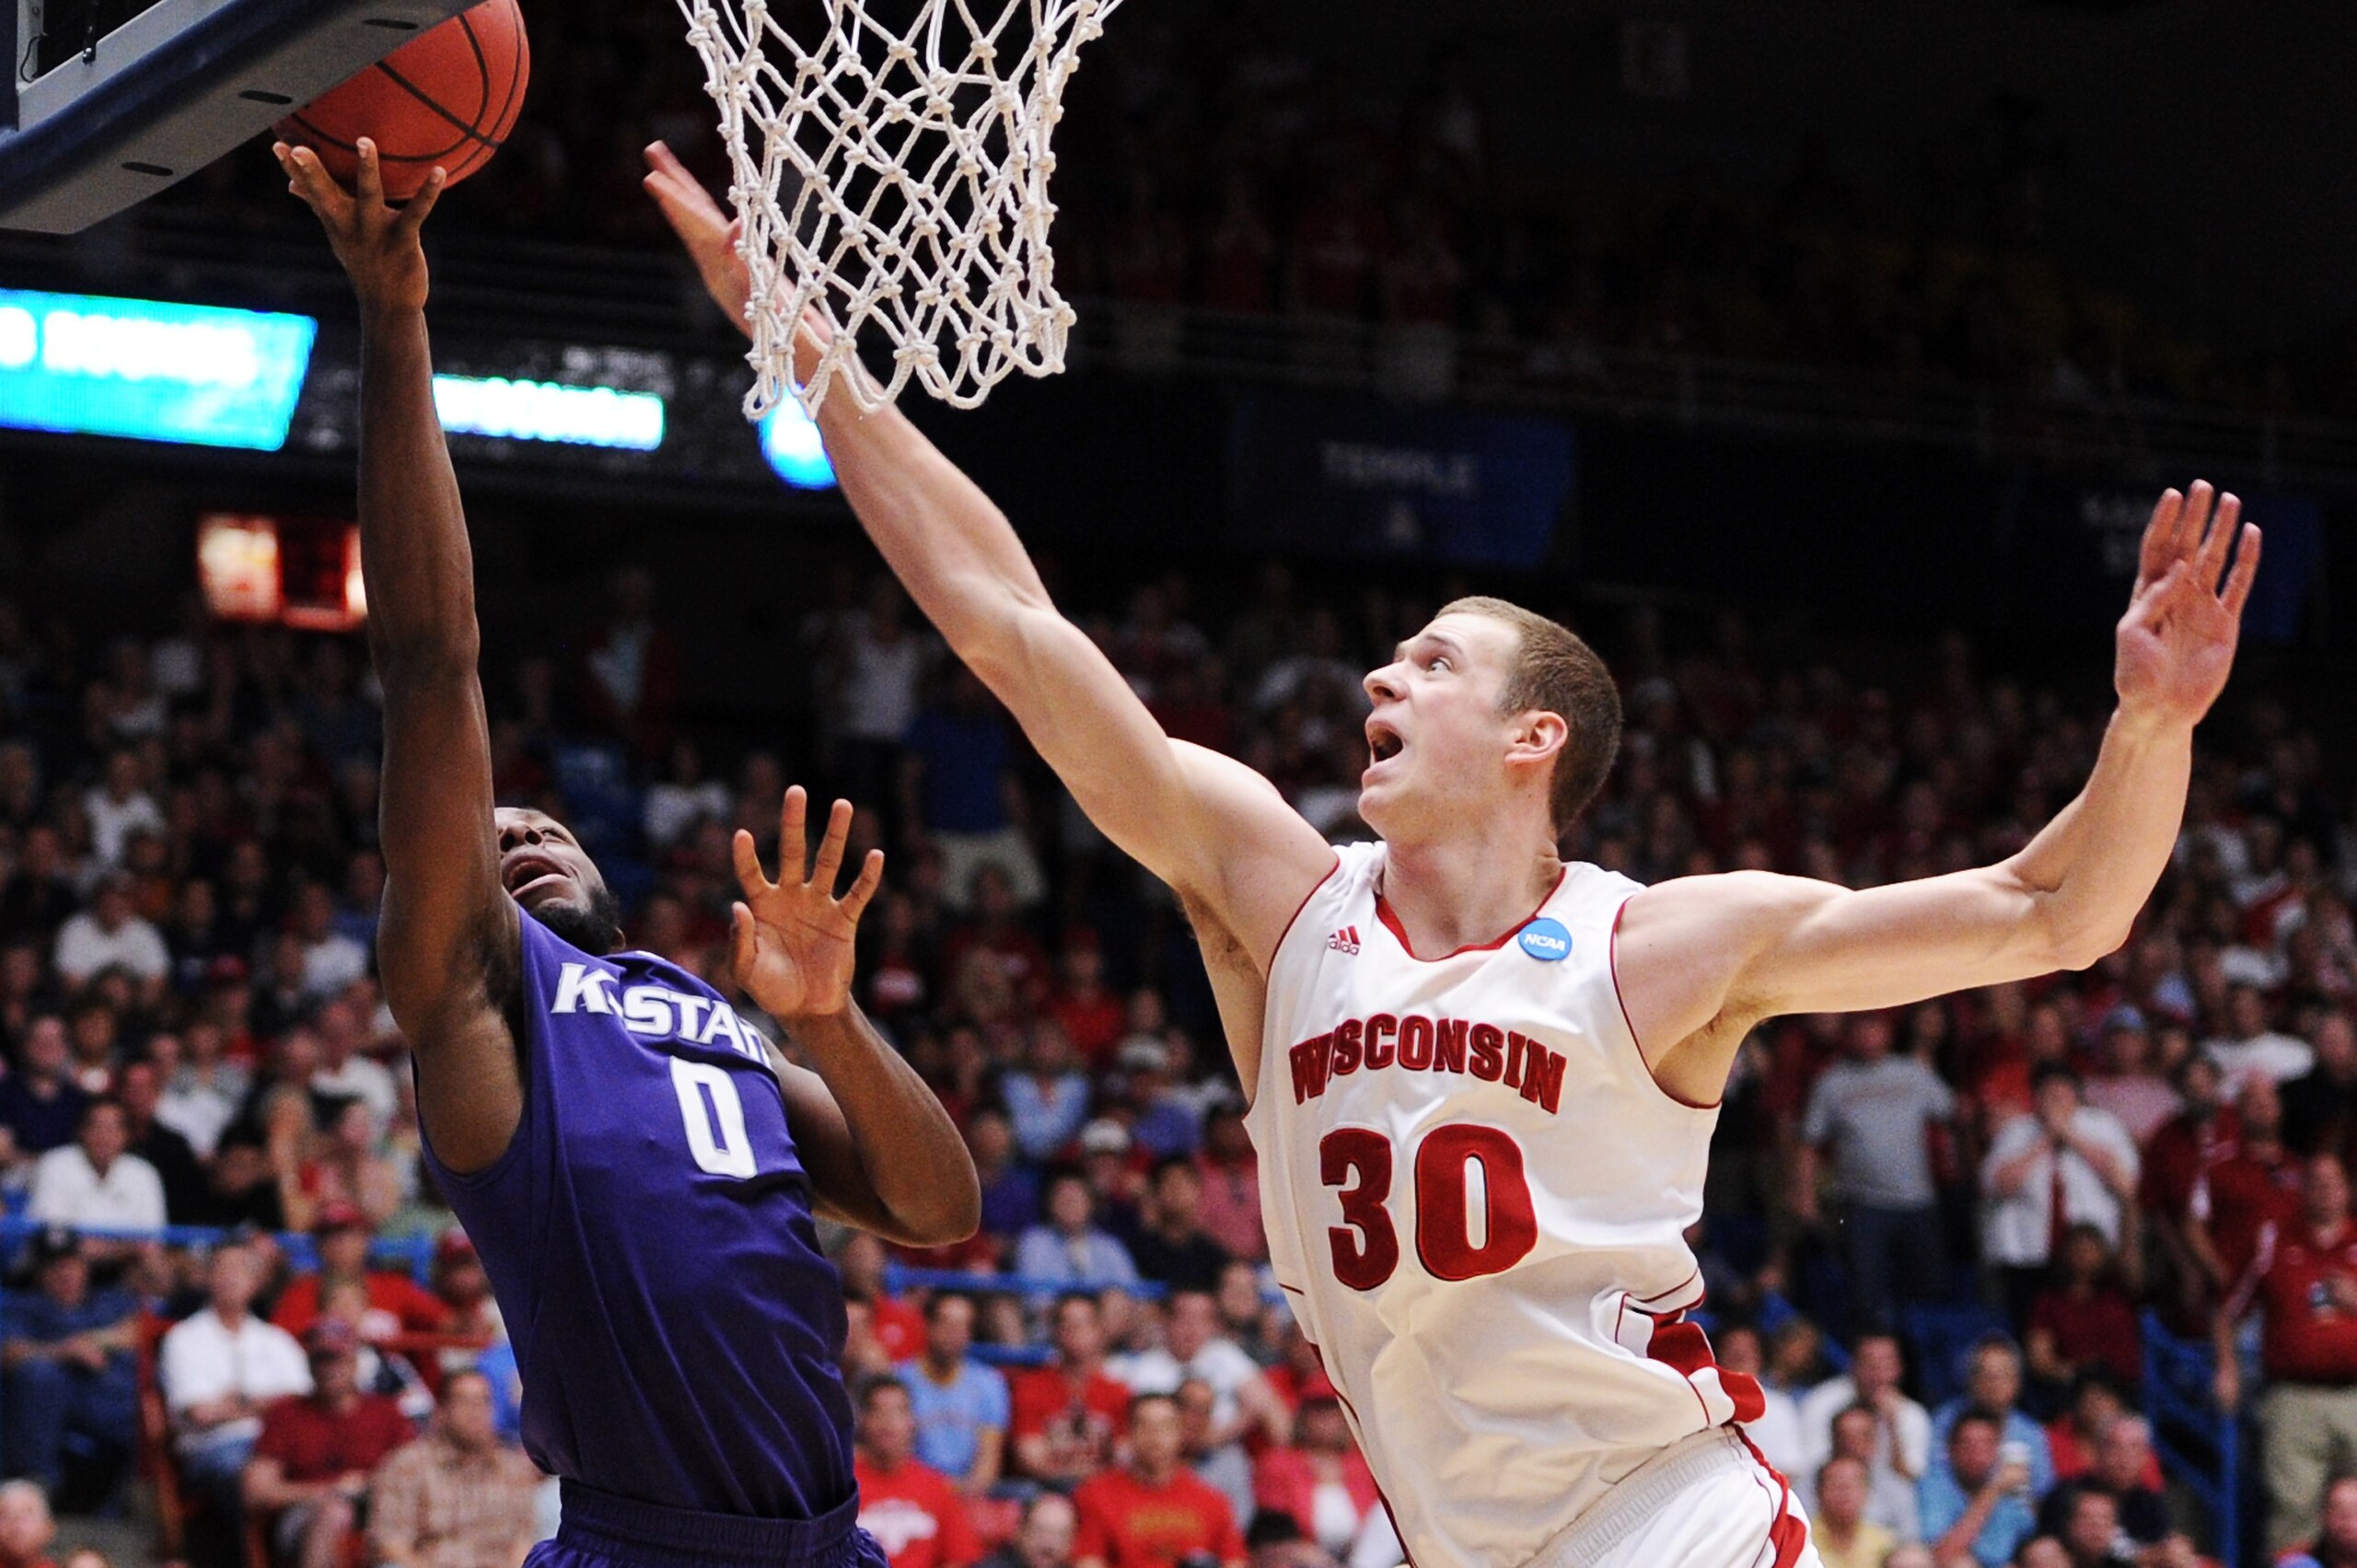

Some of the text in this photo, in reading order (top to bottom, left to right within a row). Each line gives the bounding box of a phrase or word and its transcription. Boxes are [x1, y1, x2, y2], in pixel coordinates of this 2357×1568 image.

[1524, 933, 1566, 952] NCAA
[669, 1054, 759, 1180] 0
[1289, 1013, 1567, 1115] WSCONSIN
[1319, 1123, 1538, 1292] 30
